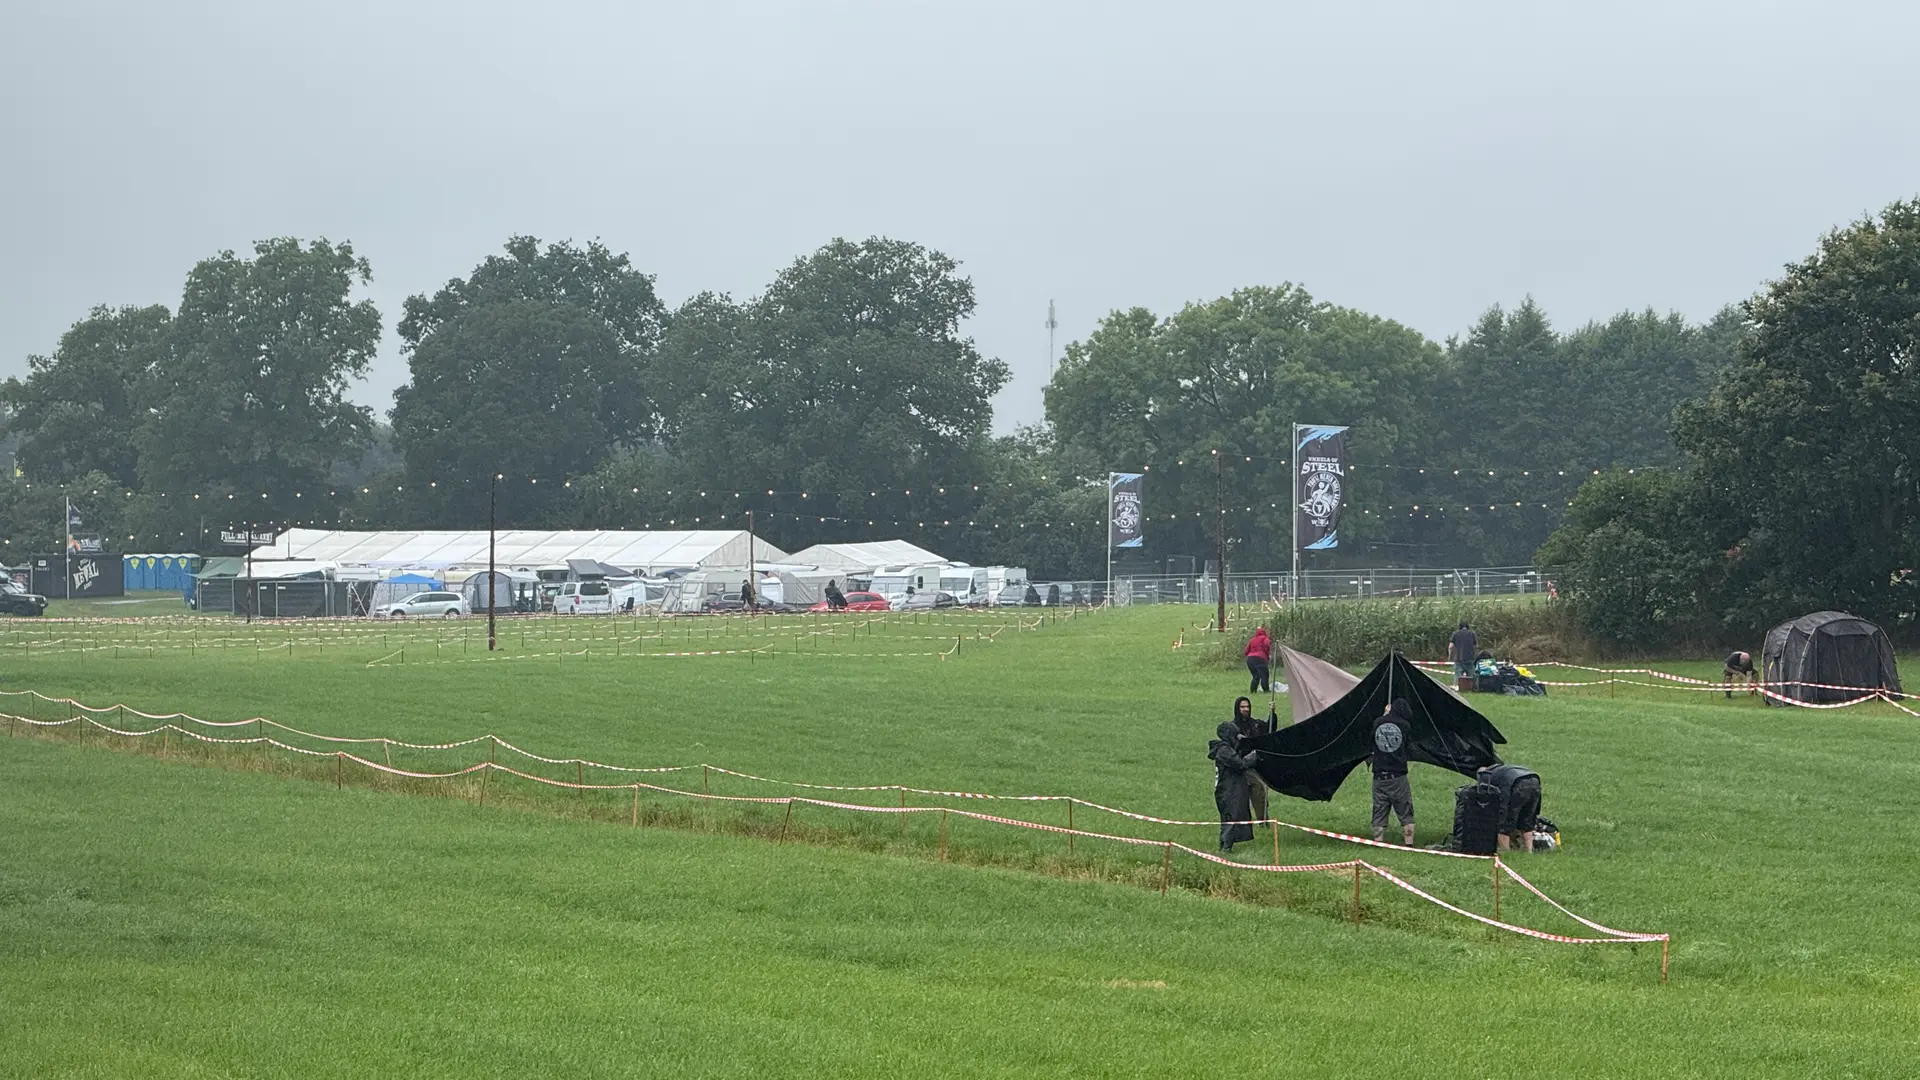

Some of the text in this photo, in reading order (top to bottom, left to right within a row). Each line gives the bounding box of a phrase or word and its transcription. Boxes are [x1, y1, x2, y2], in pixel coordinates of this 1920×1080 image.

[1301, 461, 1344, 477] STEEL
[221, 531, 235, 540] FULL
[73, 559, 99, 590] METAL
